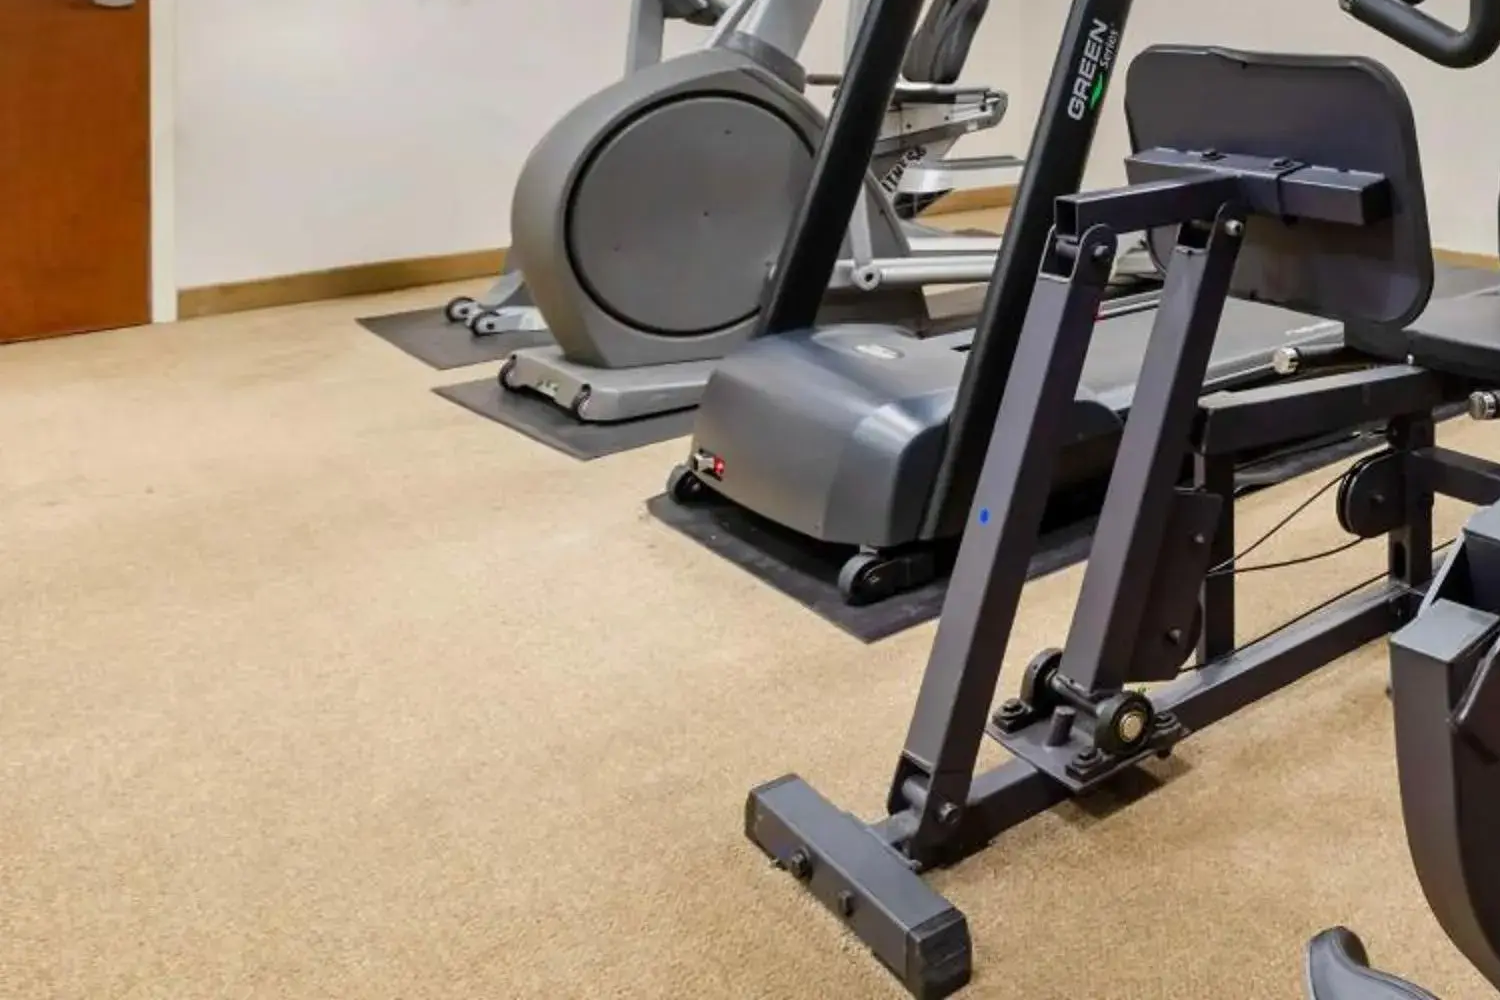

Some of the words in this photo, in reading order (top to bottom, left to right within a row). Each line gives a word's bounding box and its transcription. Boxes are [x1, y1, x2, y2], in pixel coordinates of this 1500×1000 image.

[1067, 18, 1108, 121] GREEN
[1100, 28, 1119, 70] Series
[880, 144, 928, 193] ITNESS
